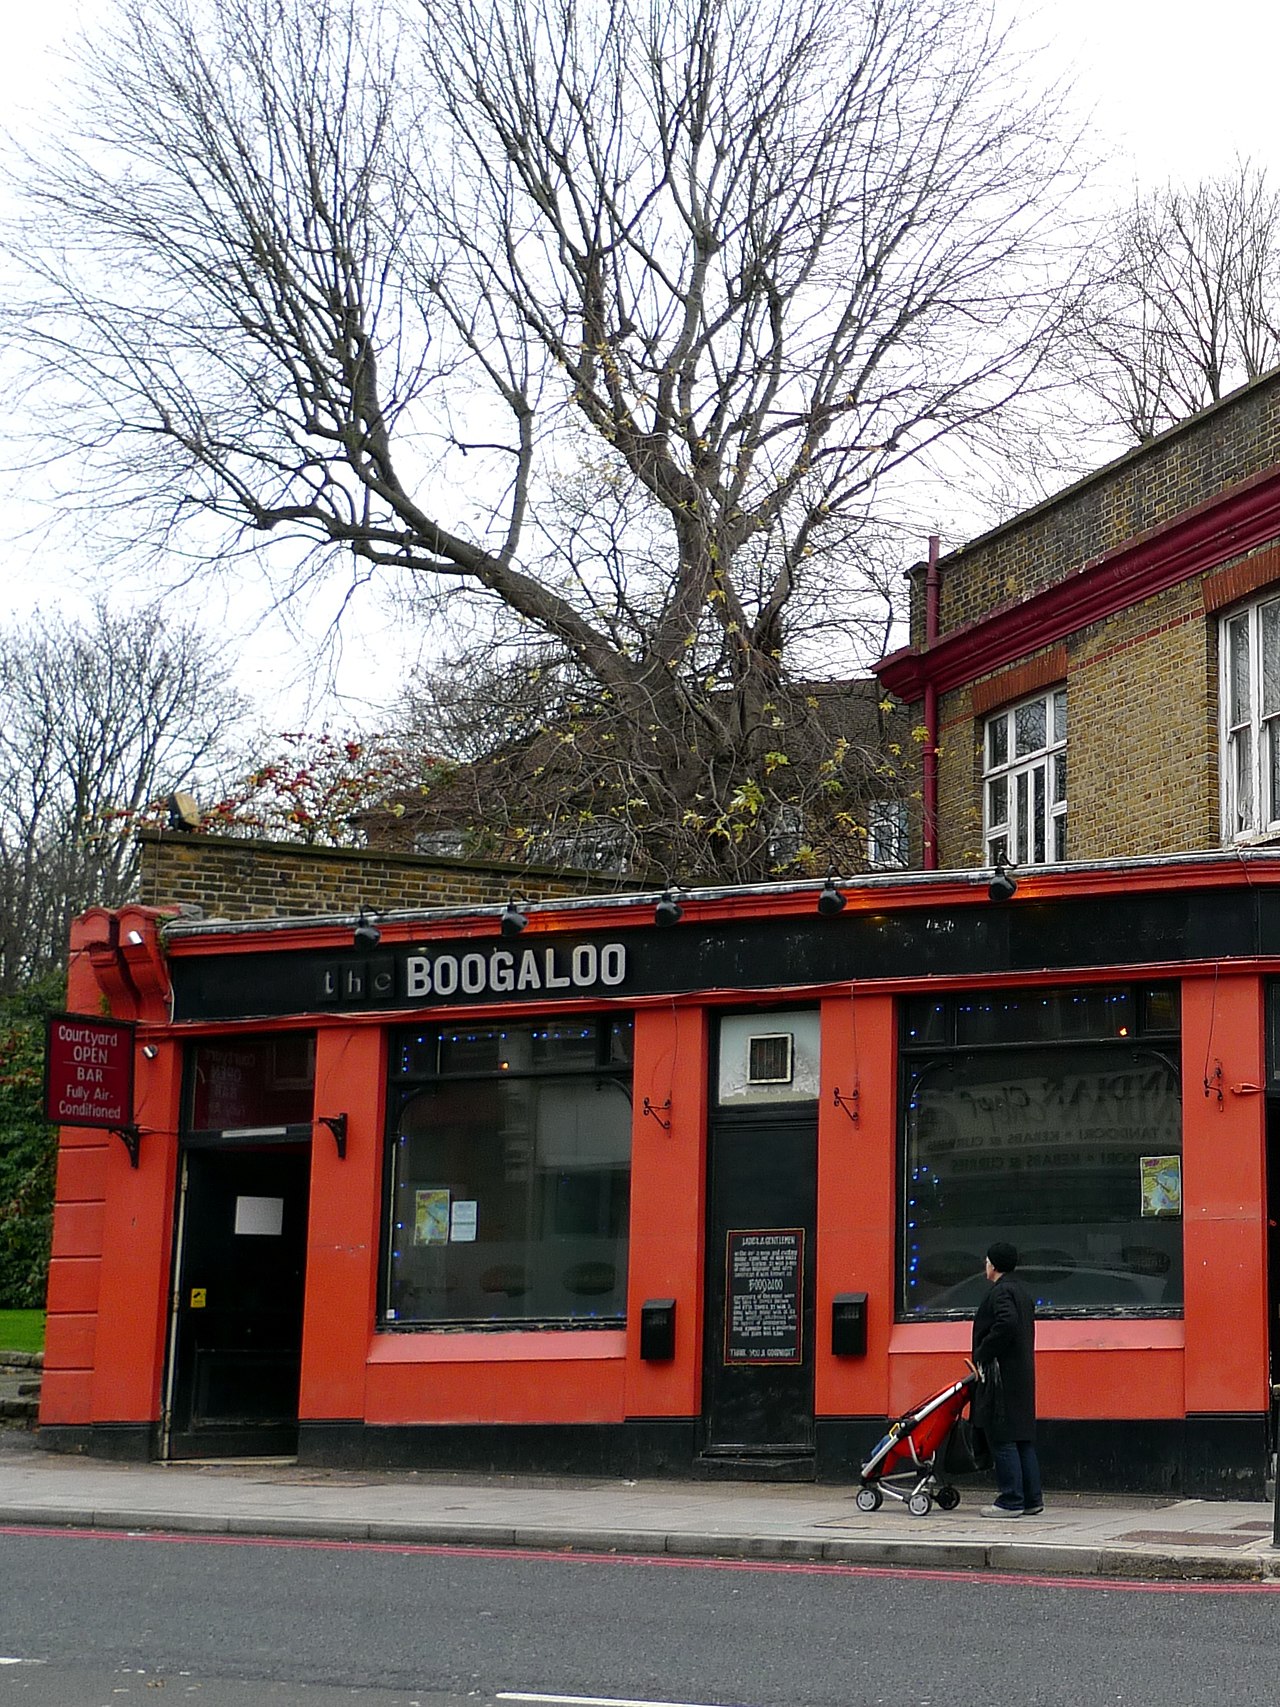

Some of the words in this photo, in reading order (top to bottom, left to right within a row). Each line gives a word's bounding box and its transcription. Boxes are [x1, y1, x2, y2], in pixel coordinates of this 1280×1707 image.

[407, 943, 627, 997] BOOGALOO
[58, 1025, 118, 1047] Courtyard
[73, 1045, 108, 1064] OPEN
[77, 1066, 103, 1083] BAR
[66, 1084, 90, 1101] Fully
[58, 1100, 121, 1119] Conditioned
